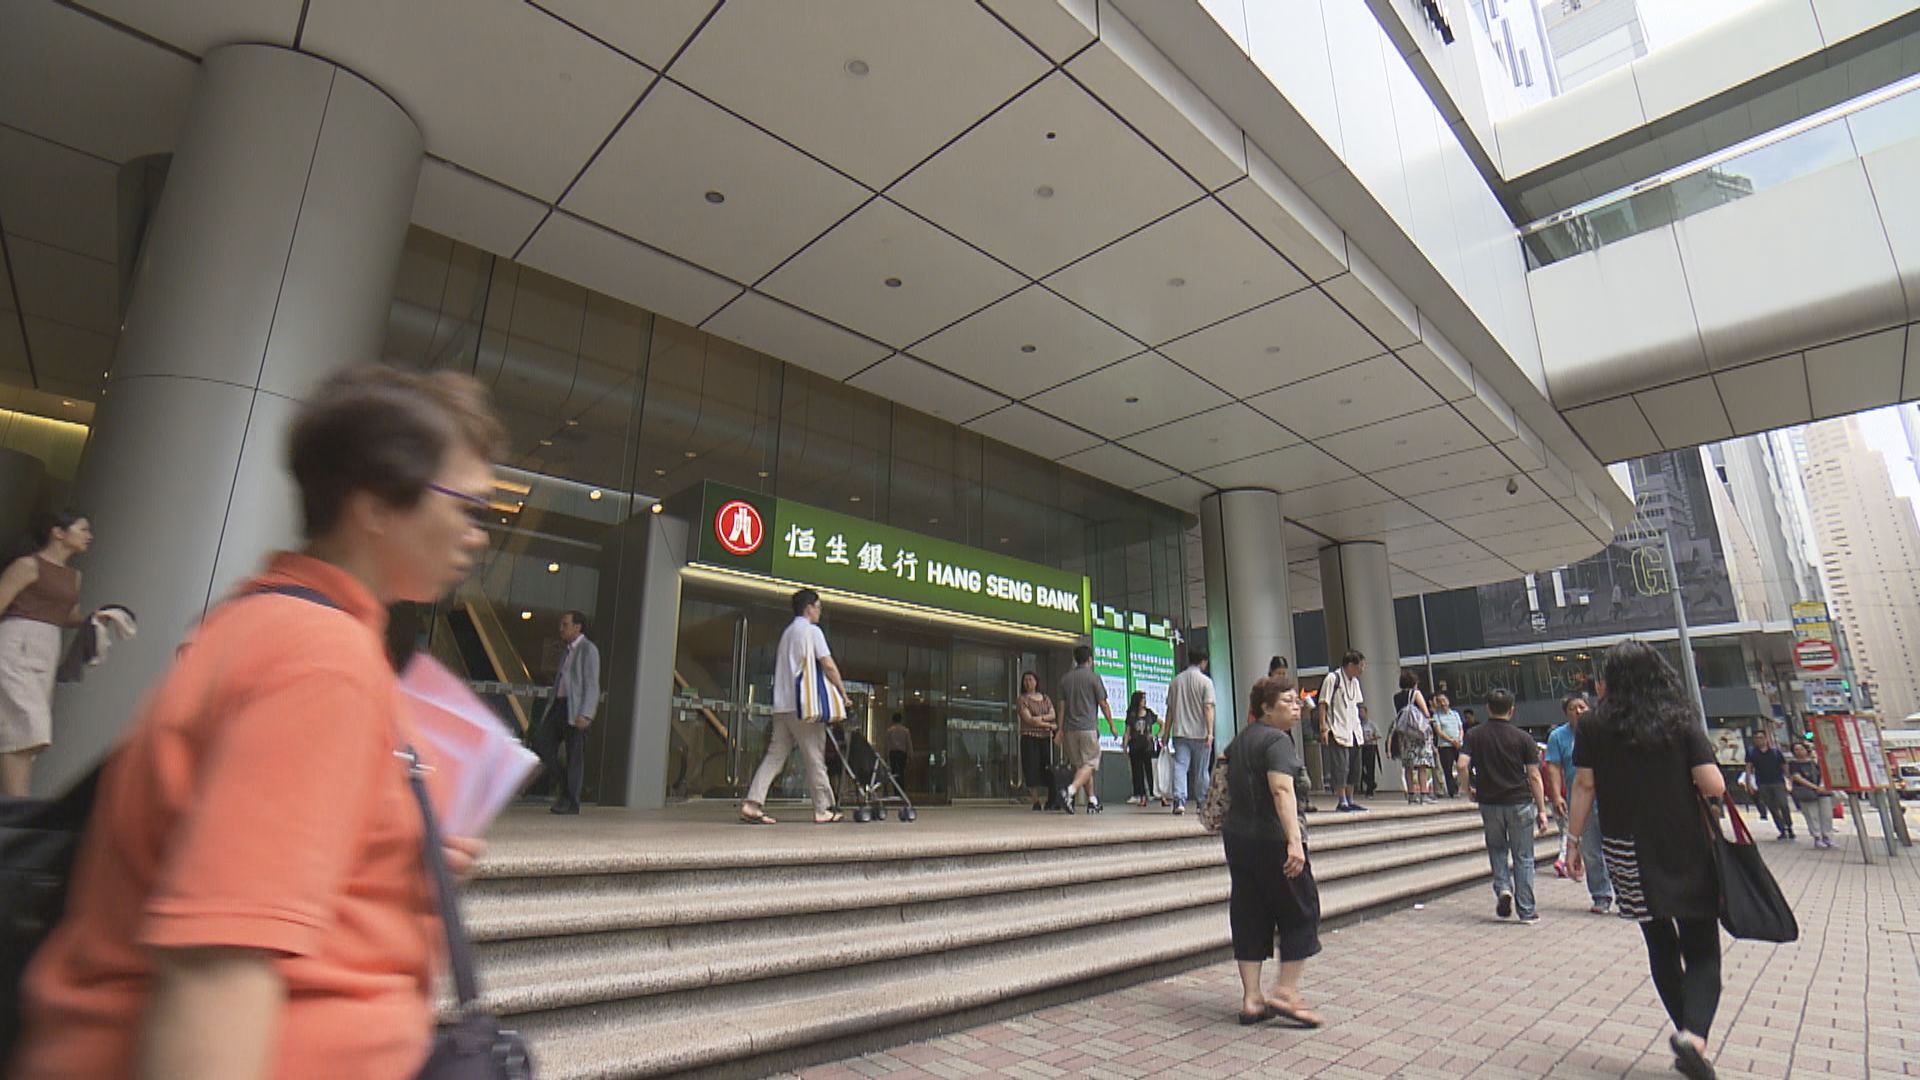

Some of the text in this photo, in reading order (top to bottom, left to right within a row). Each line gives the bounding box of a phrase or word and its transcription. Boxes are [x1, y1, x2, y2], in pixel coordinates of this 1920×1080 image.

[785, 523, 920, 582] 恒生銀行
[926, 560, 1080, 614] HANG SENG BANK
